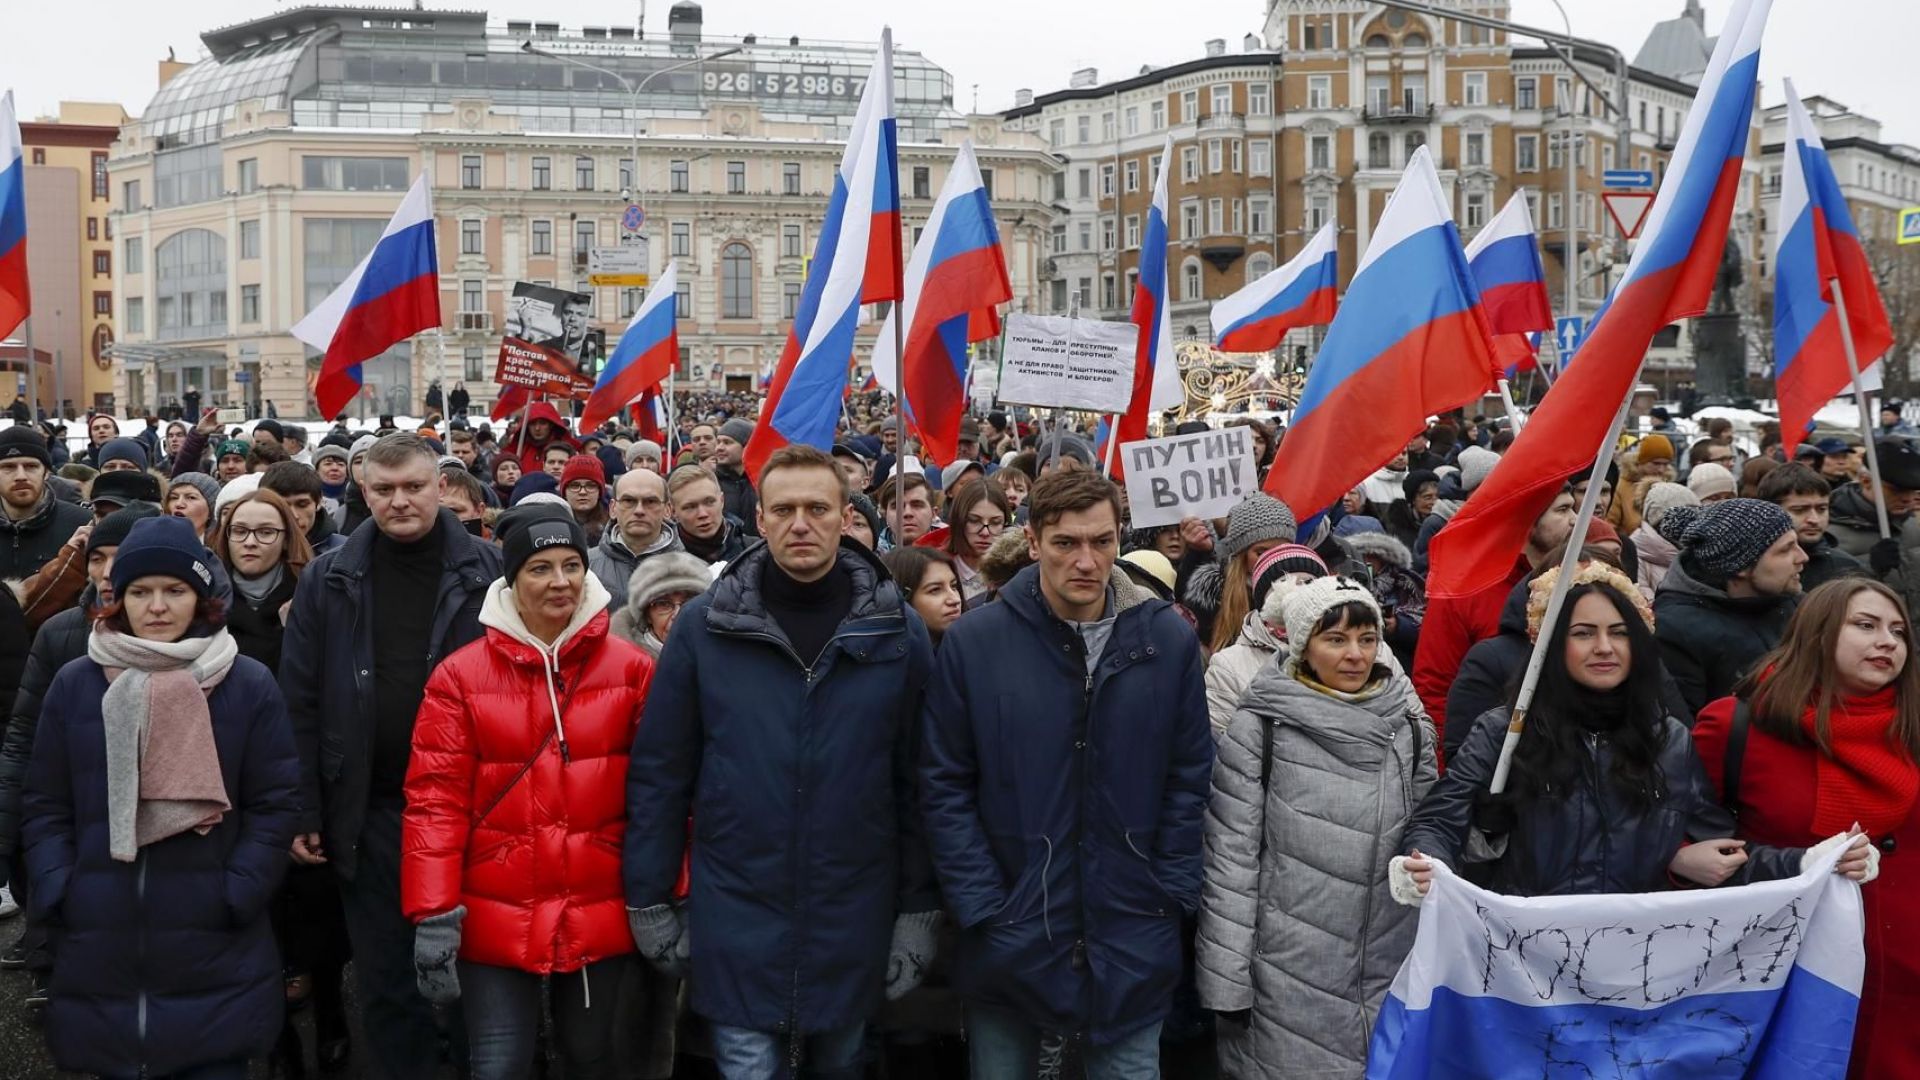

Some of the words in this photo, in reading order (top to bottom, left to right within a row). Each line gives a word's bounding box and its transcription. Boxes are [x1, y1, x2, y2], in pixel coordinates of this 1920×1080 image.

[1012, 337, 1044, 345] ТЮРЬМЫ
[1070, 342, 1118, 351] ПРЕСТУПНЫХ
[506, 356, 533, 368] крест
[504, 365, 517, 374] на
[518, 367, 571, 384] воровской
[1018, 369, 1063, 377] АКТИВИСТОВ
[1132, 431, 1245, 471] ПУТИН
[1151, 457, 1242, 508] ВОН!
